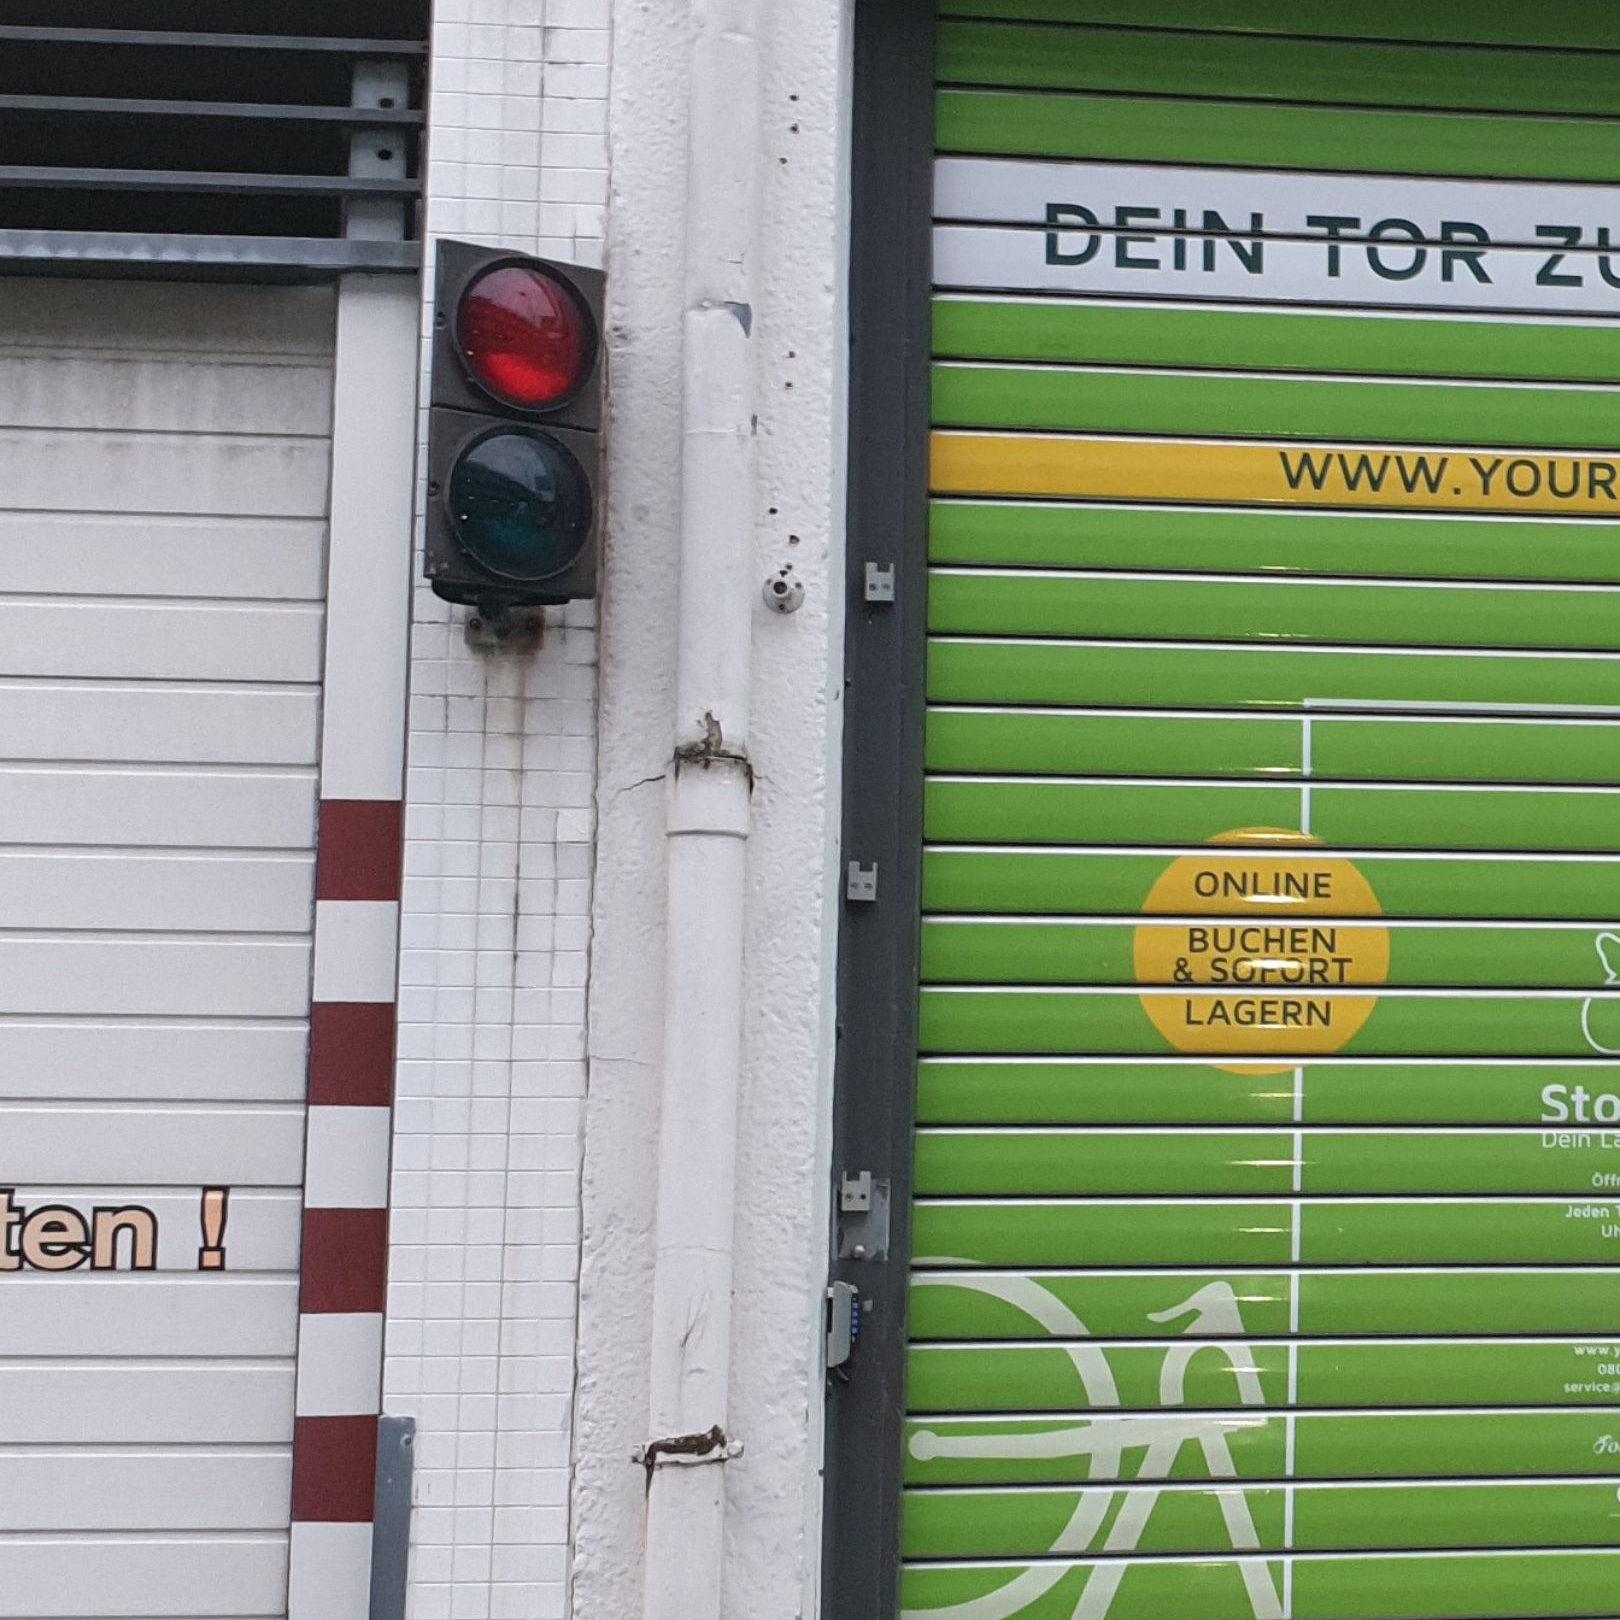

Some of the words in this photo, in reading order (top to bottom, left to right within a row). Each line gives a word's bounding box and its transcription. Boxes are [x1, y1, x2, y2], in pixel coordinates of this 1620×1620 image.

[1045, 202, 1263, 277] DEIN
[1306, 217, 1492, 285] TOR
[1194, 870, 1332, 899] ONLINE
[1188, 928, 1336, 954] BUCHEN
[1173, 957, 1193, 983] &
[1211, 957, 1353, 983] SOFORT
[1185, 999, 1331, 1027] LAGERN
[1542, 1132, 1591, 1149] Dein
[1565, 1205, 1610, 1219] Jeden
